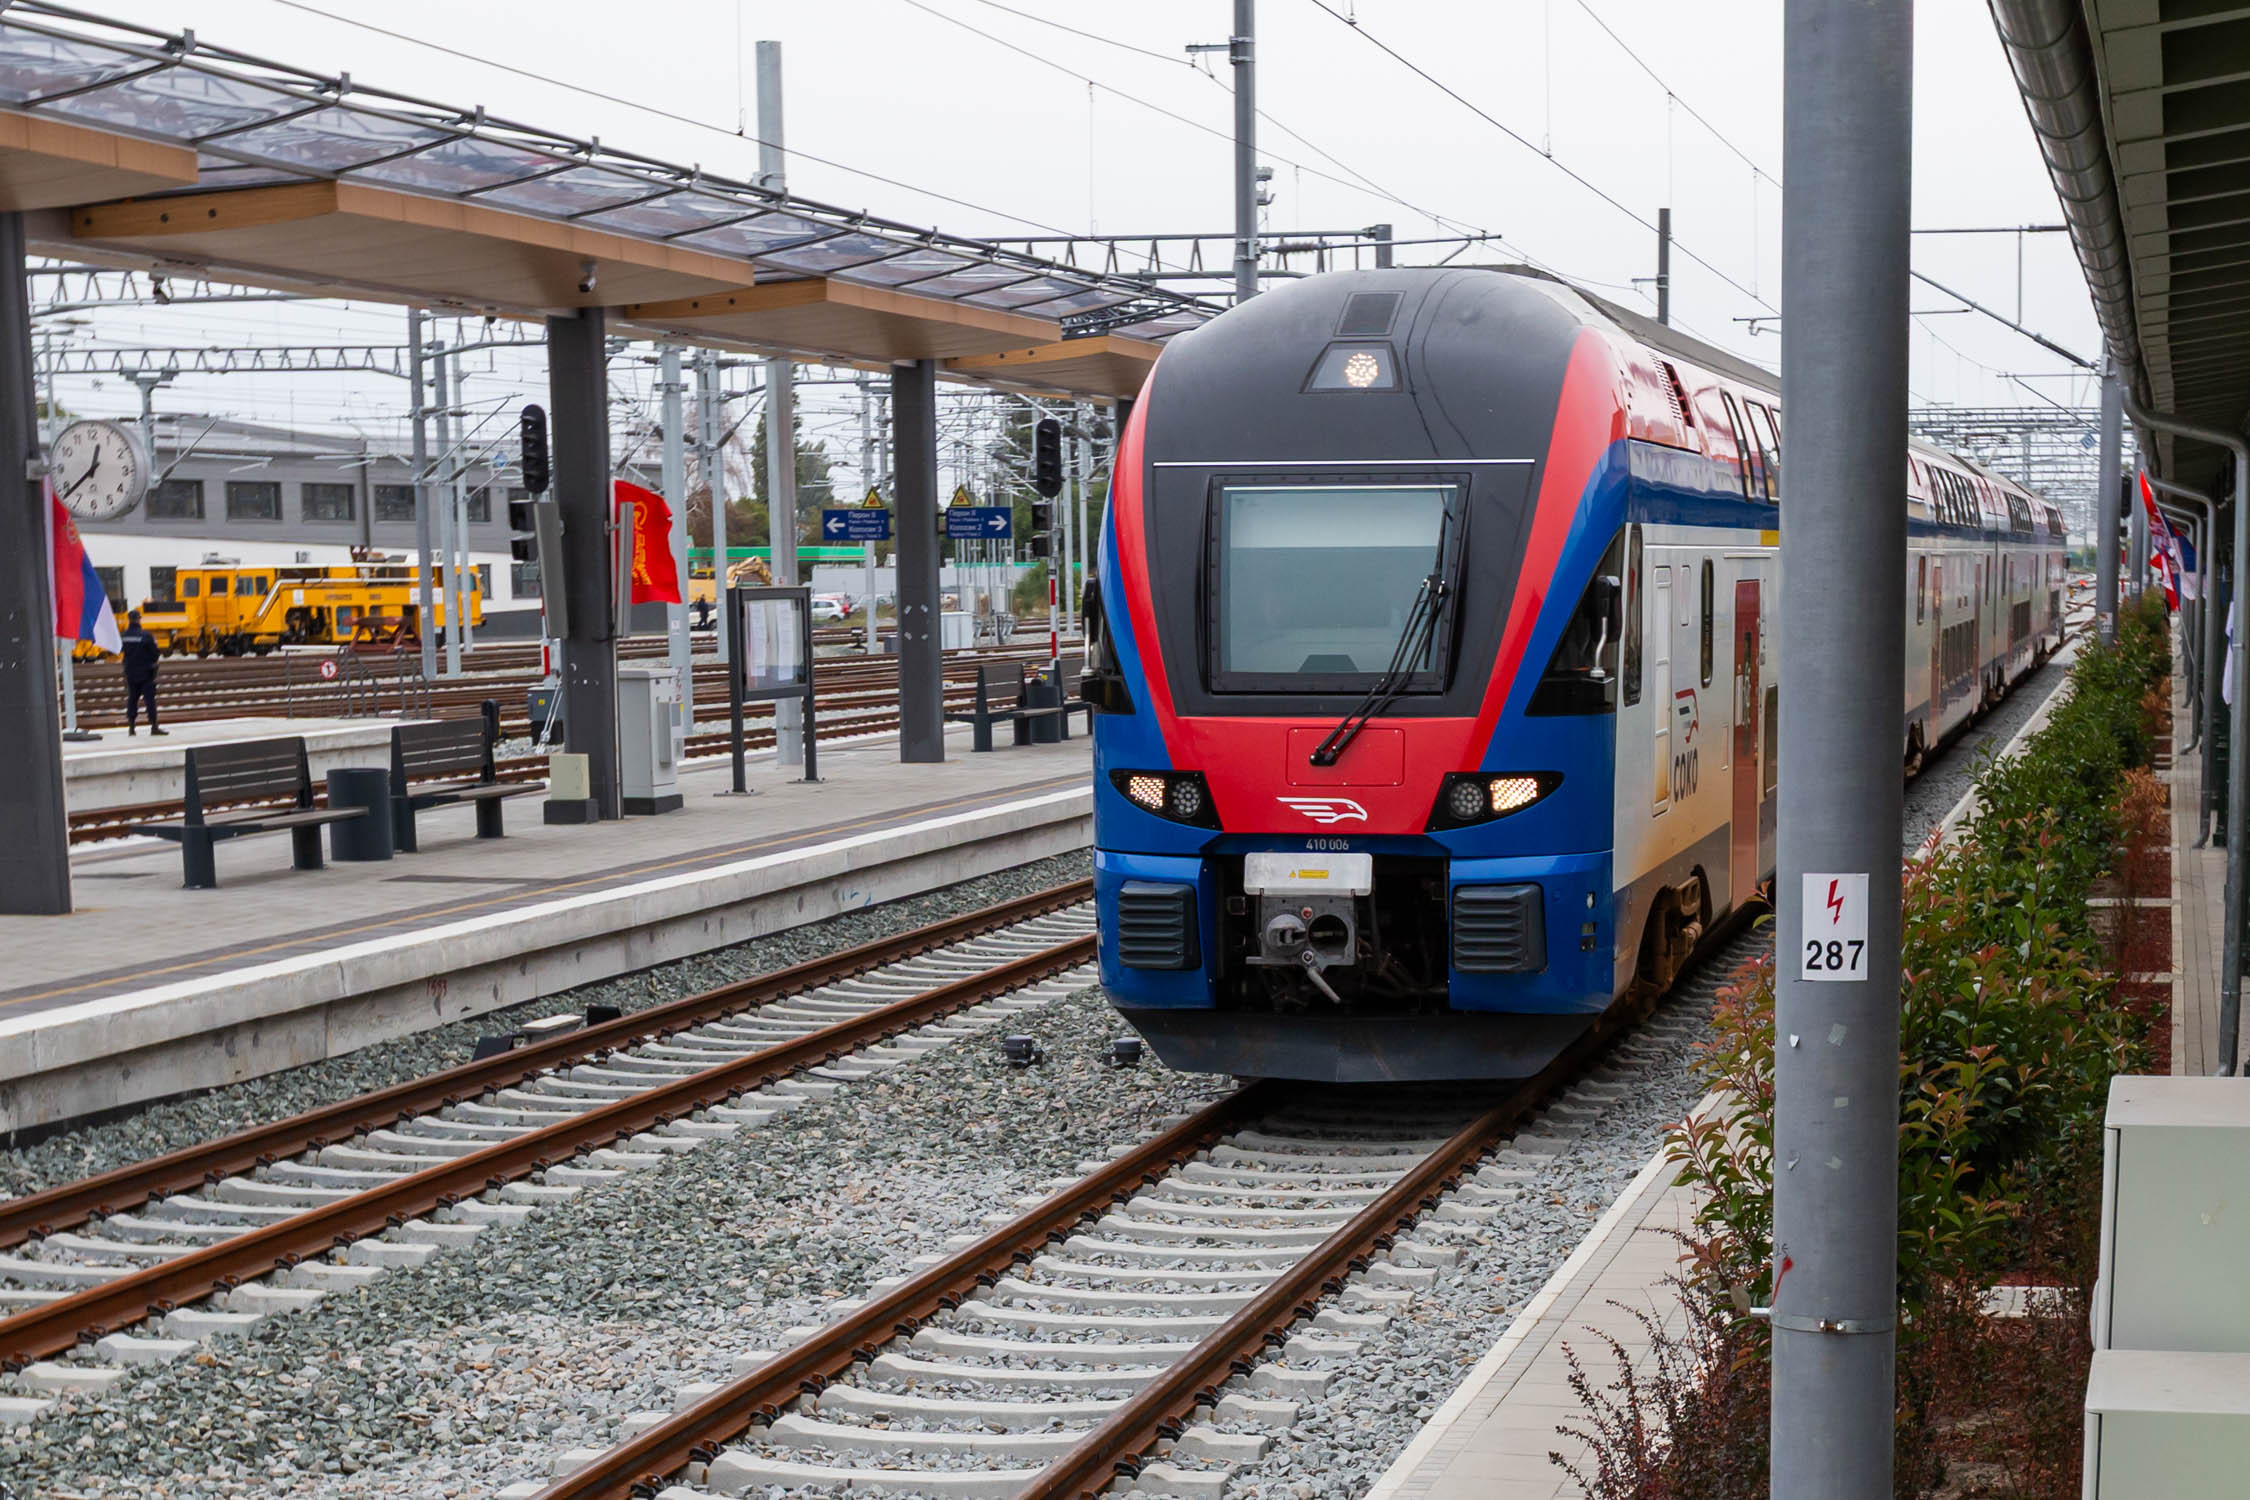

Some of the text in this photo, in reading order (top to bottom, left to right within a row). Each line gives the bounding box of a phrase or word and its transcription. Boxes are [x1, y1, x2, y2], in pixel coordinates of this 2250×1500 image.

[73, 434, 81, 444] 11
[87, 428, 98, 440] 12
[106, 435, 111, 446] 1
[62, 446, 73, 457] 10
[117, 448, 124, 459] 2
[57, 463, 65, 474] 9
[122, 465, 129, 476] 3
[116, 482, 124, 493] 4
[75, 493, 83, 505] 7
[90, 499, 98, 510] 6
[106, 494, 113, 505] 5
[1673, 748, 1699, 803] СОКО
[1306, 838, 1349, 850] 410 006
[1806, 939, 1865, 971] 287
